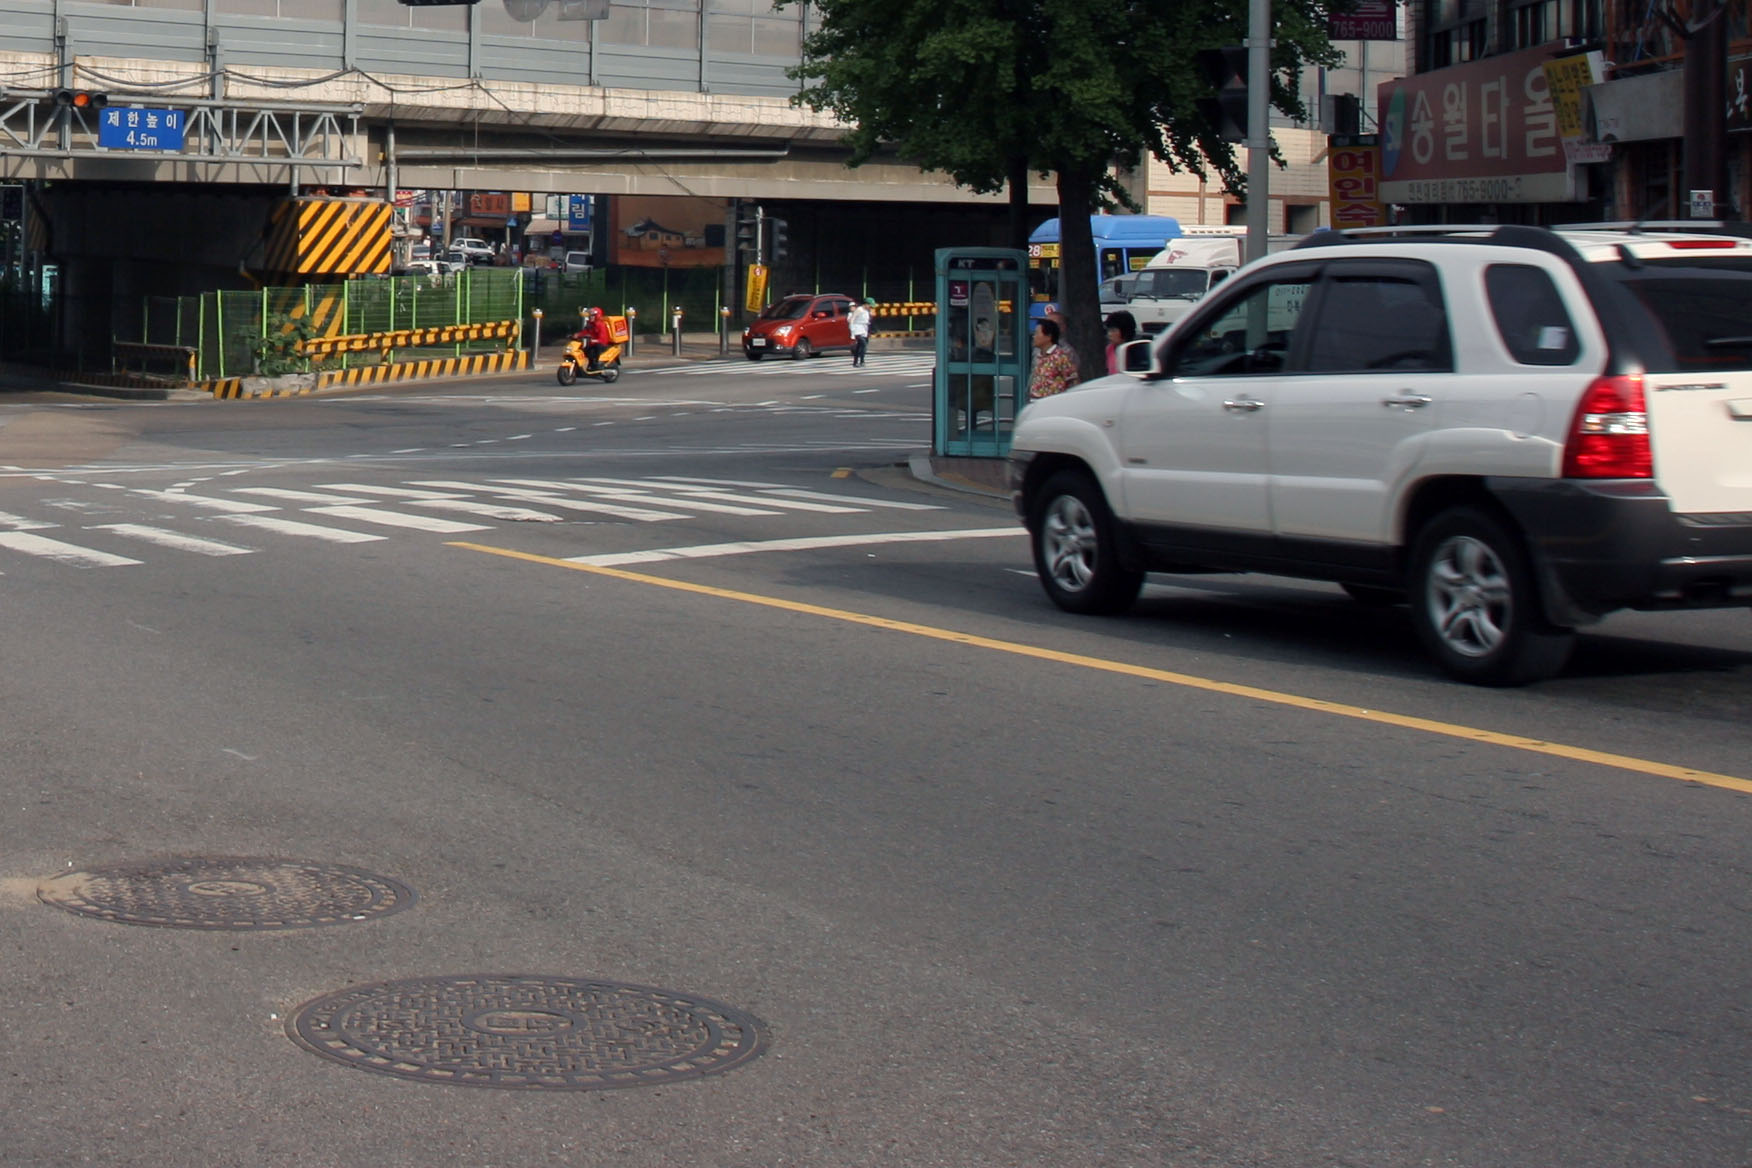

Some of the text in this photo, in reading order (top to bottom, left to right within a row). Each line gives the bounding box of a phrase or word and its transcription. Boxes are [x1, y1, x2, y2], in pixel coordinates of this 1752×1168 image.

[1333, 21, 1393, 38] 765-9000
[108, 110, 177, 129] 제한높이
[1411, 64, 1557, 165] 송월타올
[126, 130, 158, 146] 4.5m
[1334, 151, 1379, 226] 여인숙
[957, 259, 976, 269] KT
